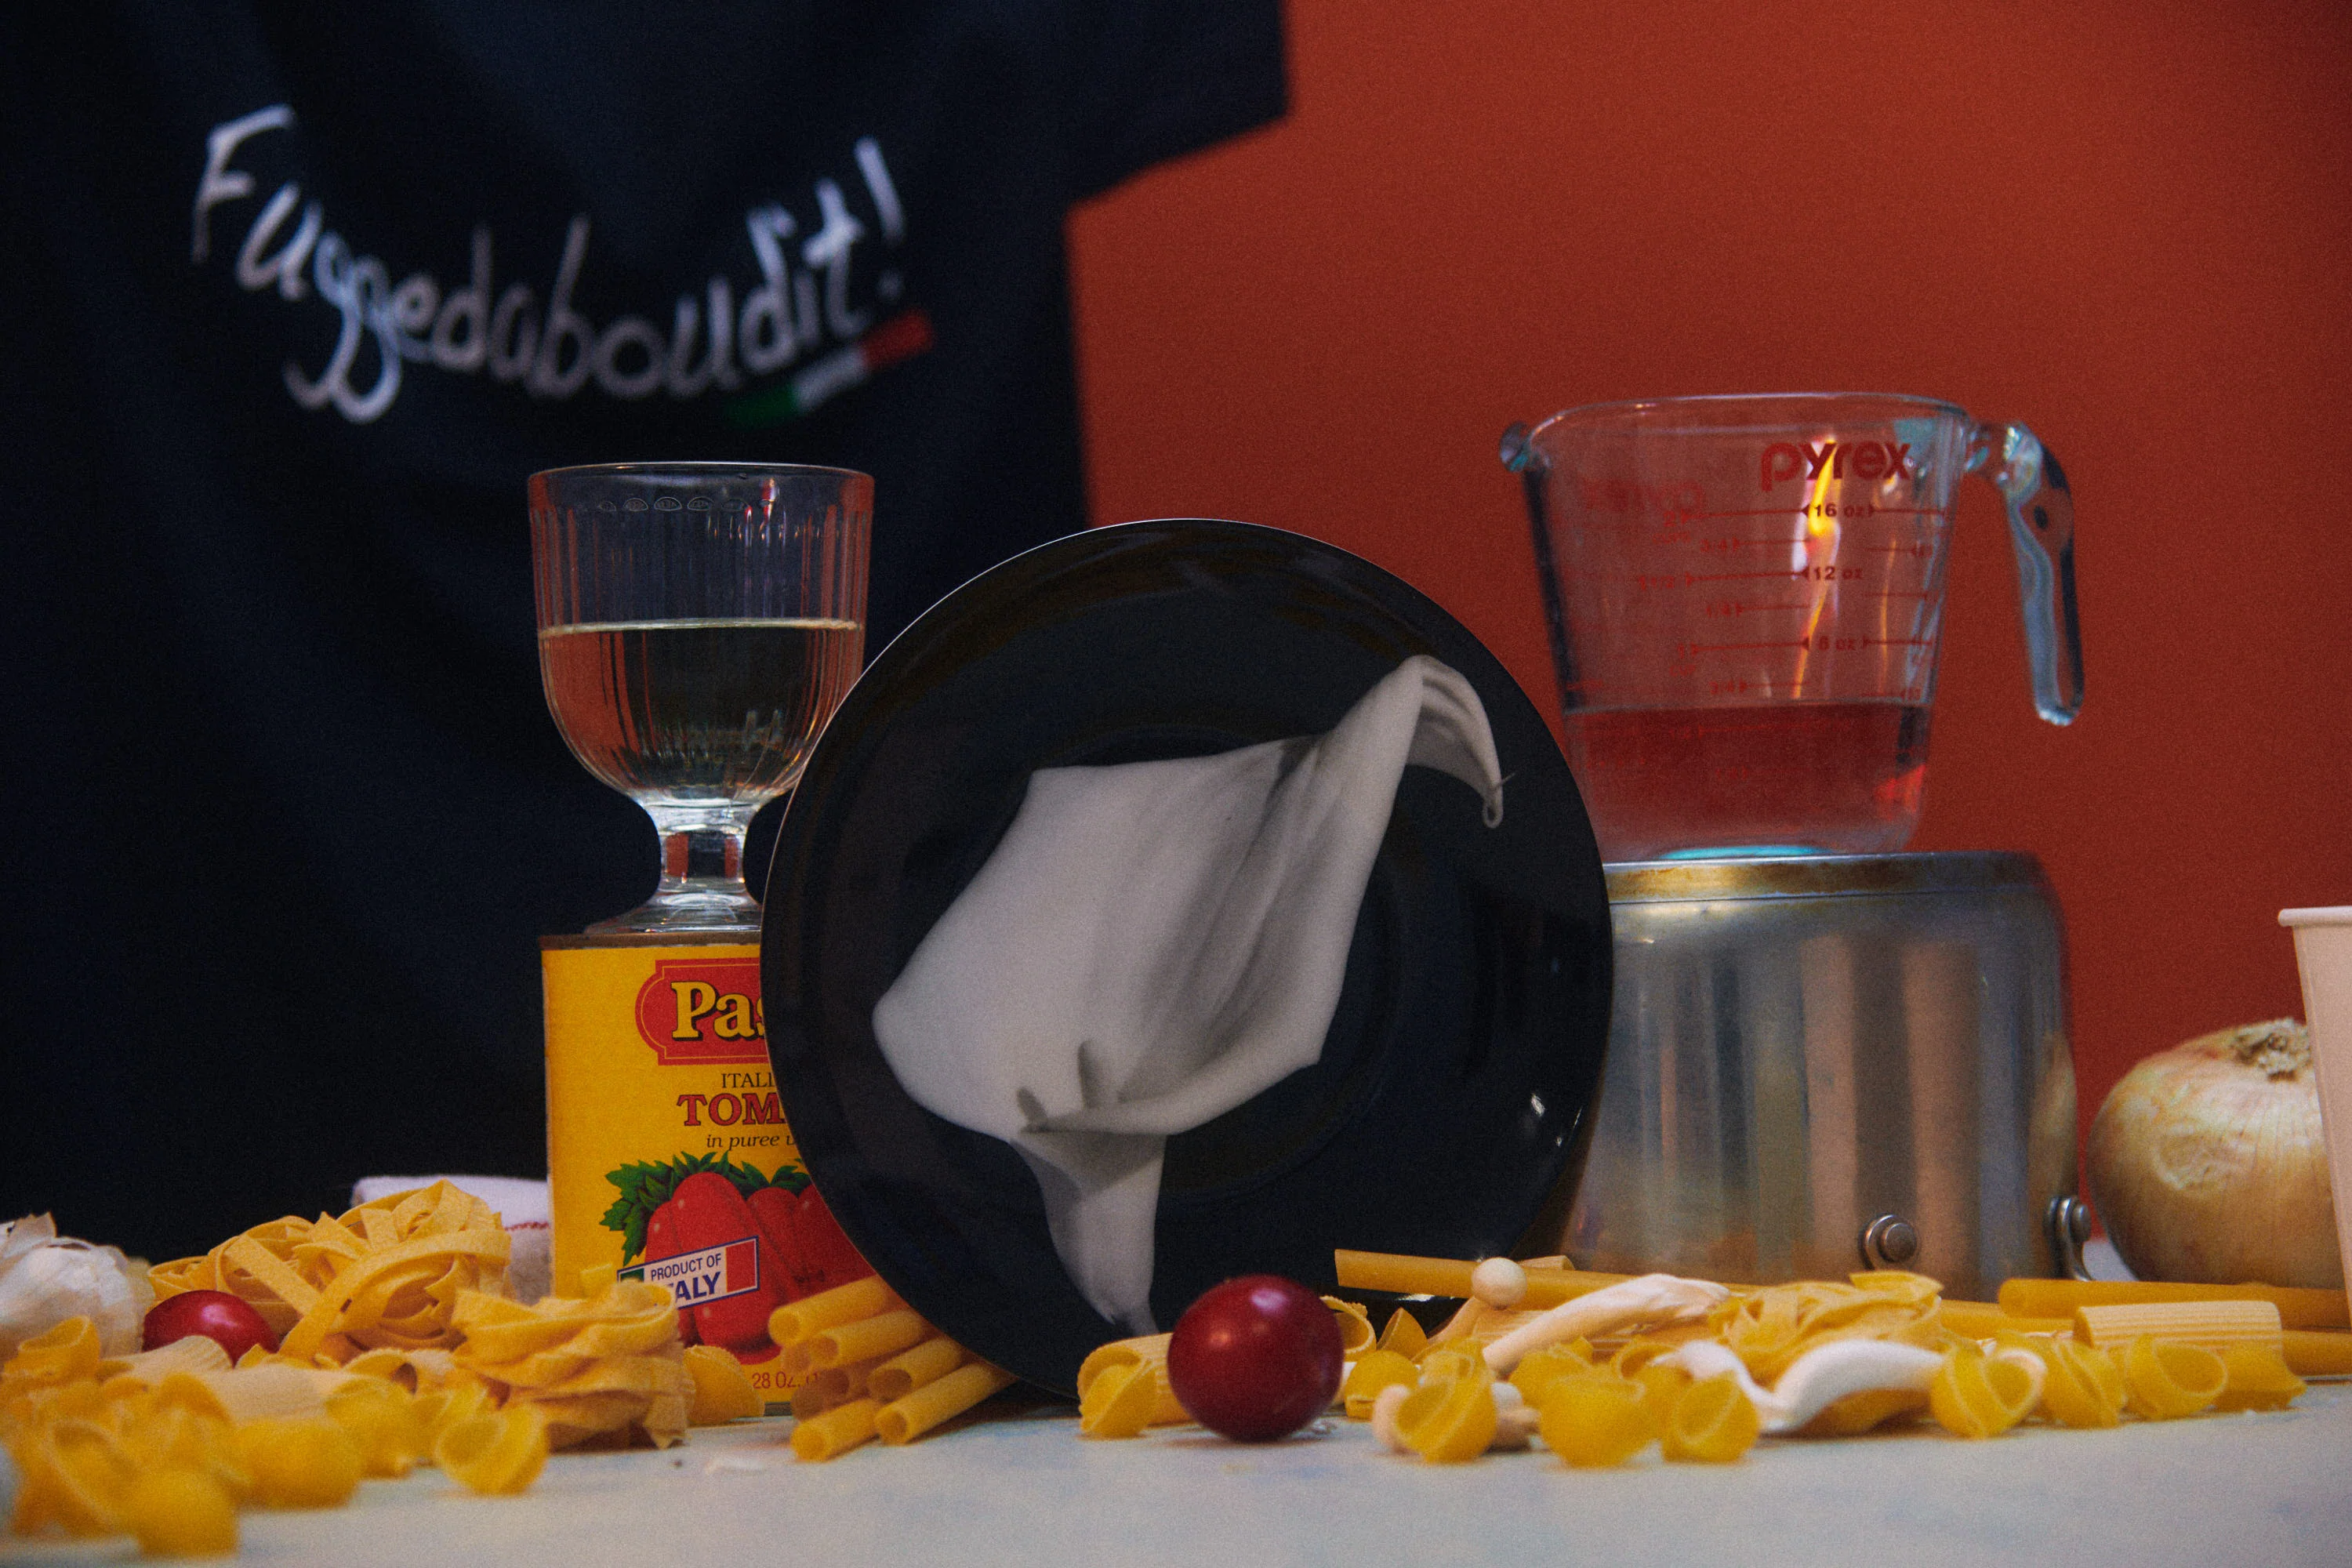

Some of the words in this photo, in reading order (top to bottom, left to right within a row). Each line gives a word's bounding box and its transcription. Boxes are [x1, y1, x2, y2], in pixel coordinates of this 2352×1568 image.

[1760, 440, 1911, 492] pyrex
[1814, 503, 1838, 518] 16
[1813, 566, 1836, 581] 12
[1843, 568, 1864, 580] oz
[706, 1134, 724, 1149] in
[728, 1135, 780, 1151] puree
[650, 1257, 703, 1282] PRODUCT
[706, 1253, 722, 1269] OF
[666, 1271, 721, 1304] ALY
[753, 1371, 771, 1389] 28
